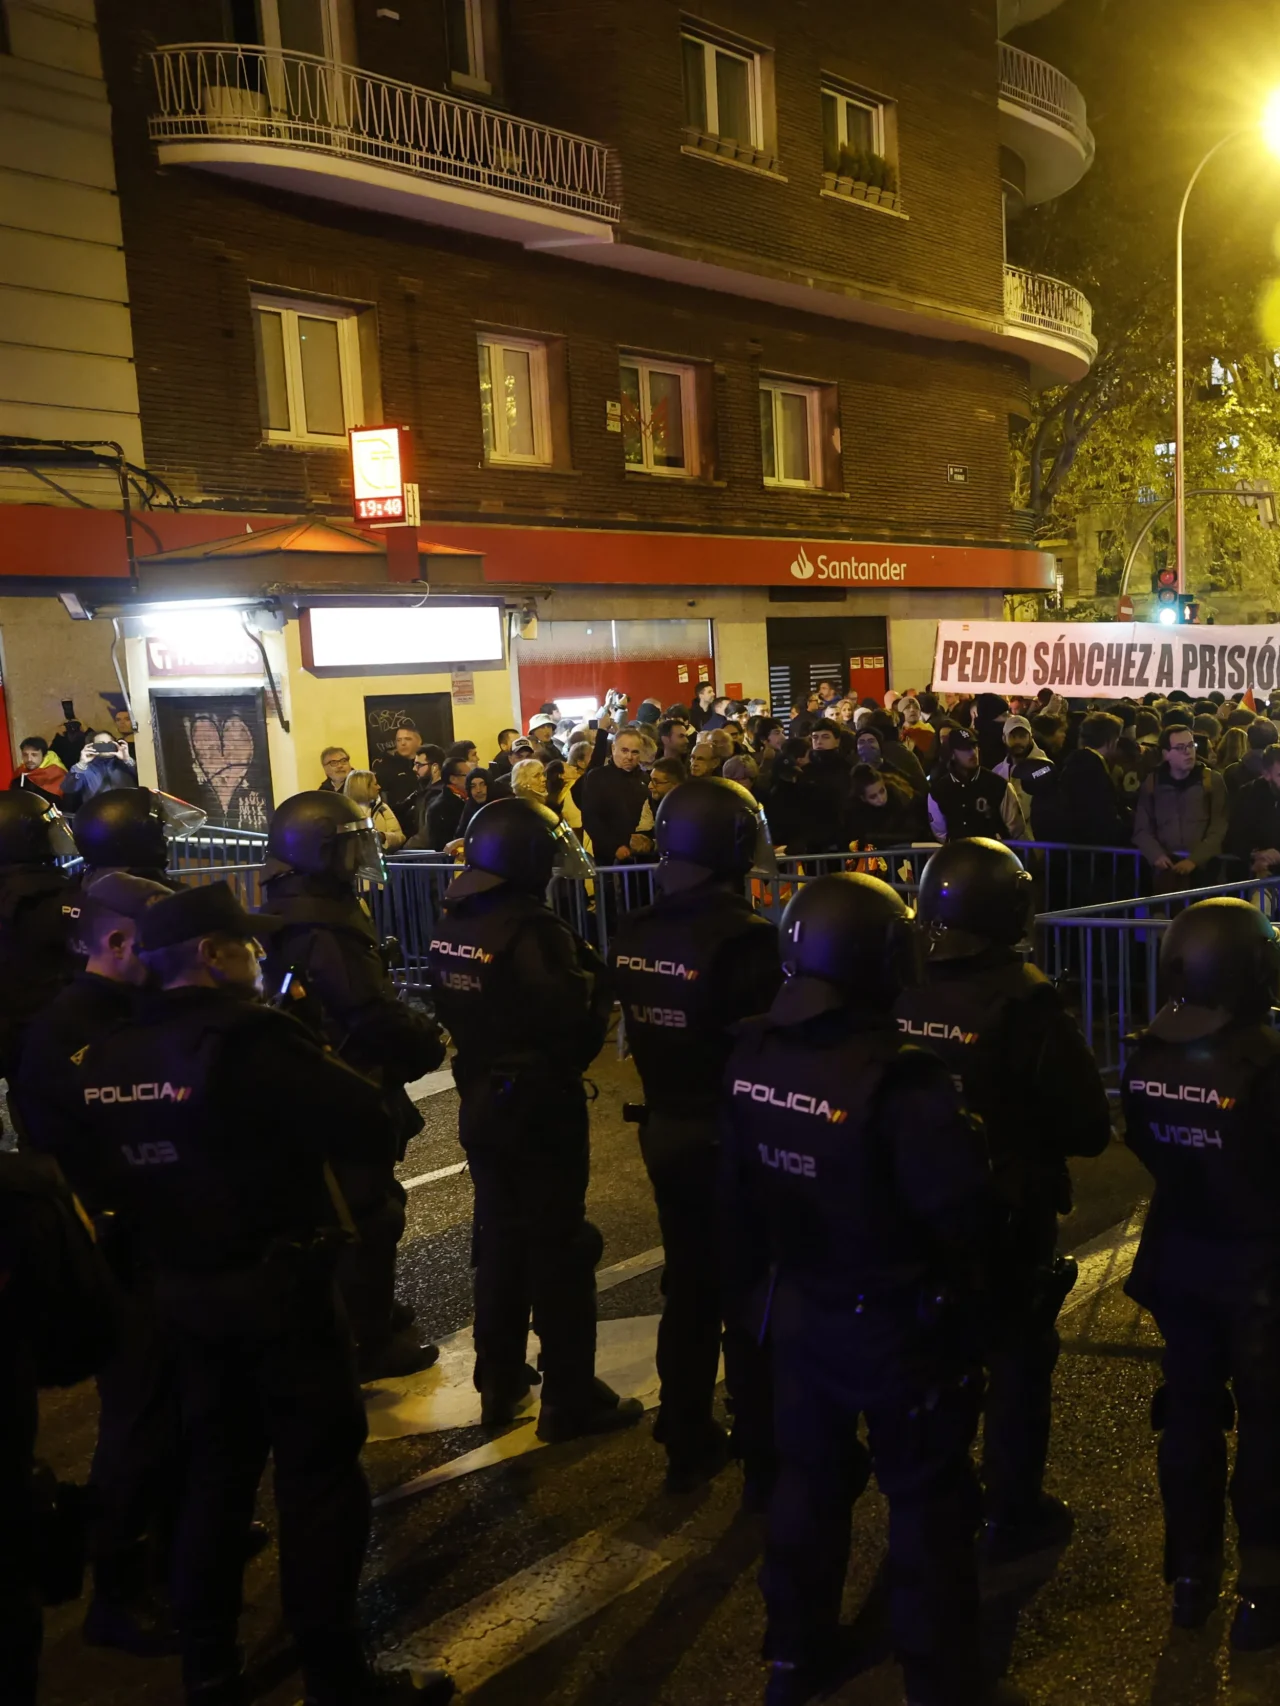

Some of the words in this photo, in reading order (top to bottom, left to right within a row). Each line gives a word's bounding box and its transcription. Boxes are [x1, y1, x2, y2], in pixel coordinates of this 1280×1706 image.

[817, 554, 907, 581] Santander
[940, 640, 1027, 685] PEDRO
[1033, 634, 1150, 688] SÁNCHEZ
[1155, 644, 1174, 688] A
[429, 940, 485, 961] POLICIA
[616, 955, 687, 979] POLICIA
[896, 1018, 963, 1042] OLICIA
[83, 1081, 176, 1105] POLICIA
[733, 1079, 831, 1120] POLICIA
[1129, 1080, 1221, 1108] POLICIA
[1148, 1121, 1222, 1149] 1U1024
[757, 1142, 817, 1178] 1U102
